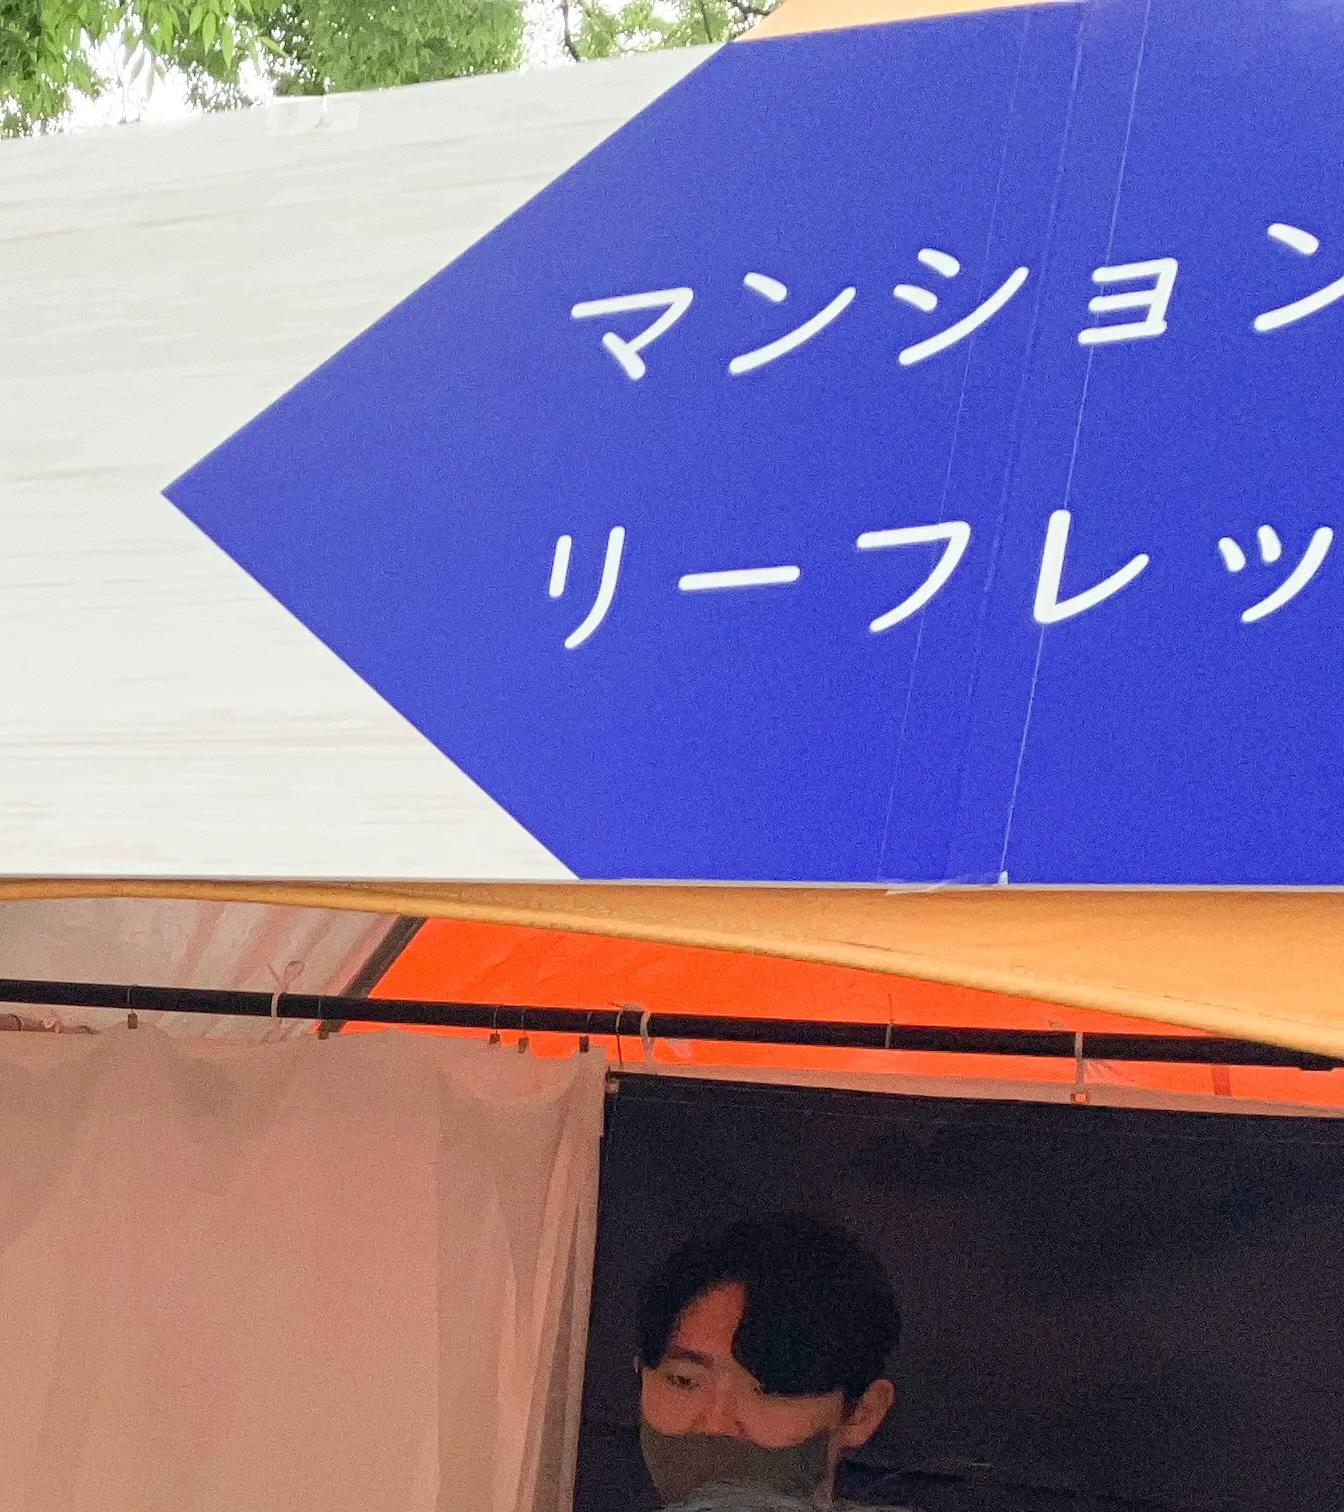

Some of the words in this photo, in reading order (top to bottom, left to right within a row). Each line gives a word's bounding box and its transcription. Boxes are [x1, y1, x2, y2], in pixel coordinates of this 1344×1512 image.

[570, 223, 1344, 379] マンション
[549, 510, 1334, 648] リーフレッ
